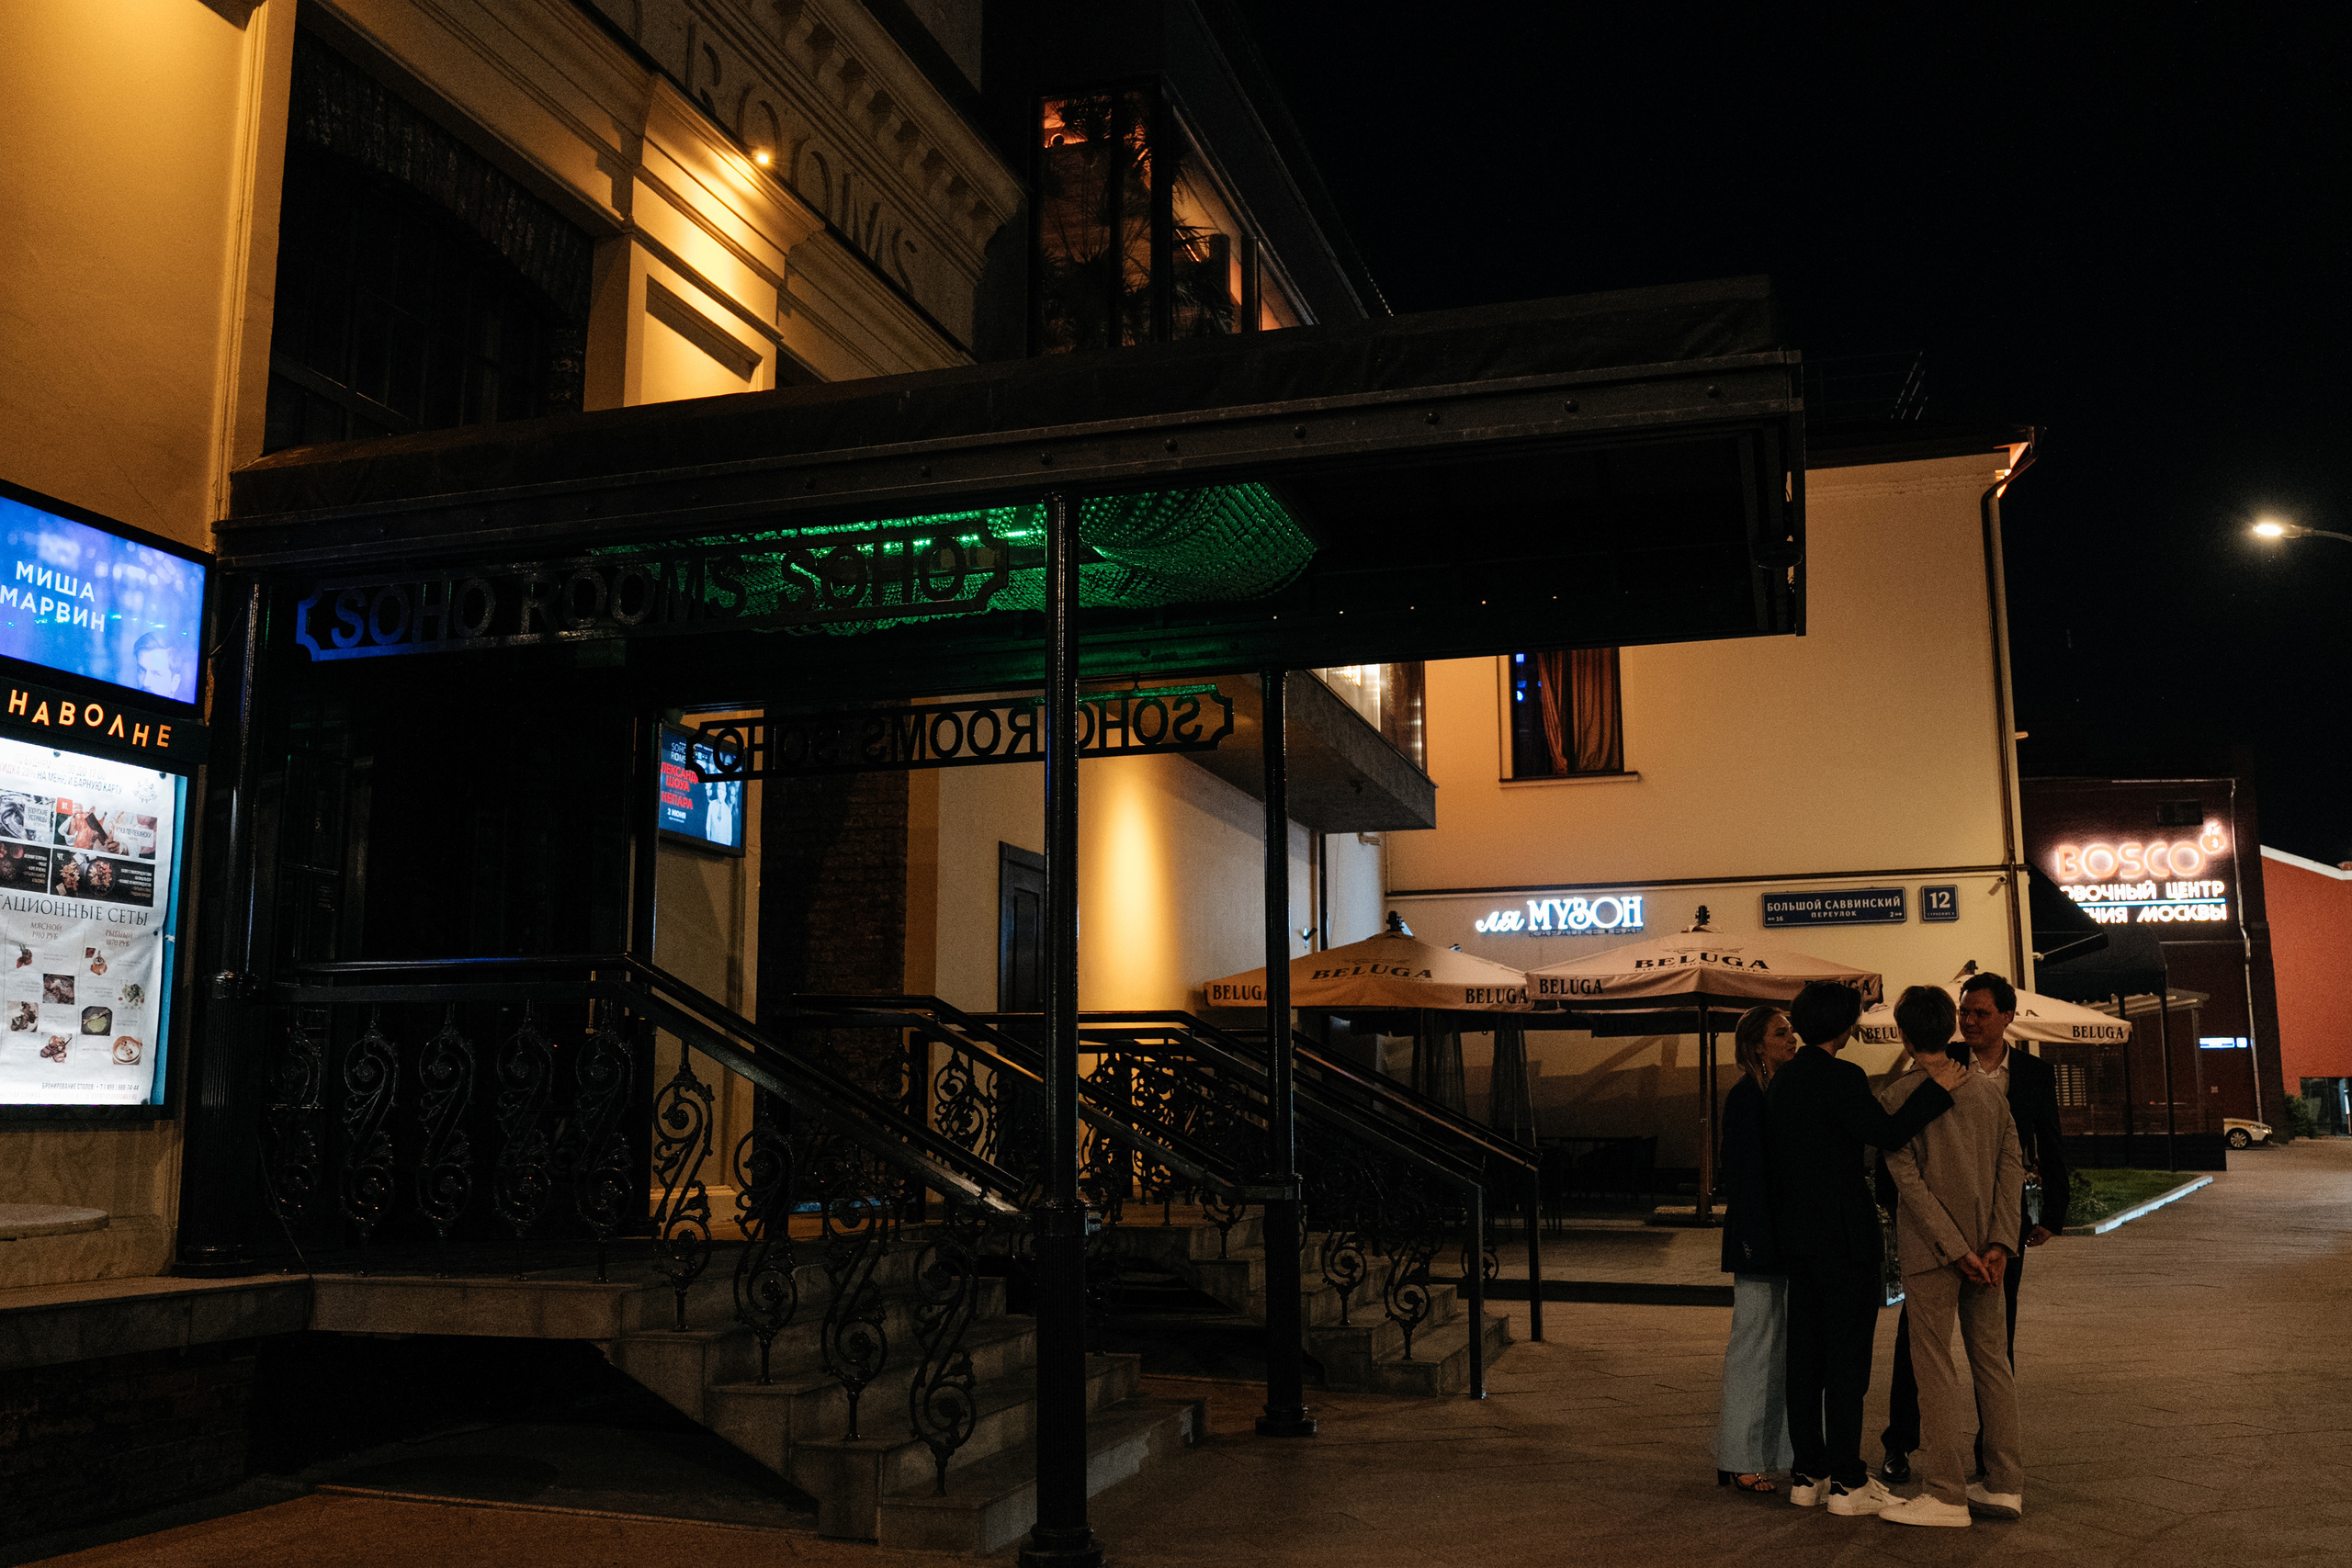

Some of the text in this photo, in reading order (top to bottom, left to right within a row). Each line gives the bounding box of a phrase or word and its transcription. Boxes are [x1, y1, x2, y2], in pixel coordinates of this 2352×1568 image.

[16, 560, 96, 603] МИША
[331, 536, 965, 649] SOHO ROOMS SOHO
[0, 584, 106, 633] МАРВИН
[2056, 840, 2206, 879] BOSCO
[2165, 880, 2225, 901] ЦЕНТР
[1767, 896, 1901, 912] БОЛЬШОЙ САВВИНСКИЙ
[1929, 891, 1951, 909] 12
[107, 908, 148, 926] СЕТЫ
[1526, 896, 1645, 931] МУЗОН
[1811, 910, 1858, 919] ПЕРЕУЛОК
[2136, 904, 2228, 923] МОСКВЫ
[30, 921, 62, 931] МЯСНОЙ
[1635, 952, 1770, 970] BELUGA
[1311, 964, 1433, 980] BELUGA
[1539, 978, 1603, 995] BELUGA
[1465, 988, 1528, 1004] BELUGA
[1866, 1027, 1898, 1040] BELU
[2072, 1025, 2124, 1039] BELUGA
